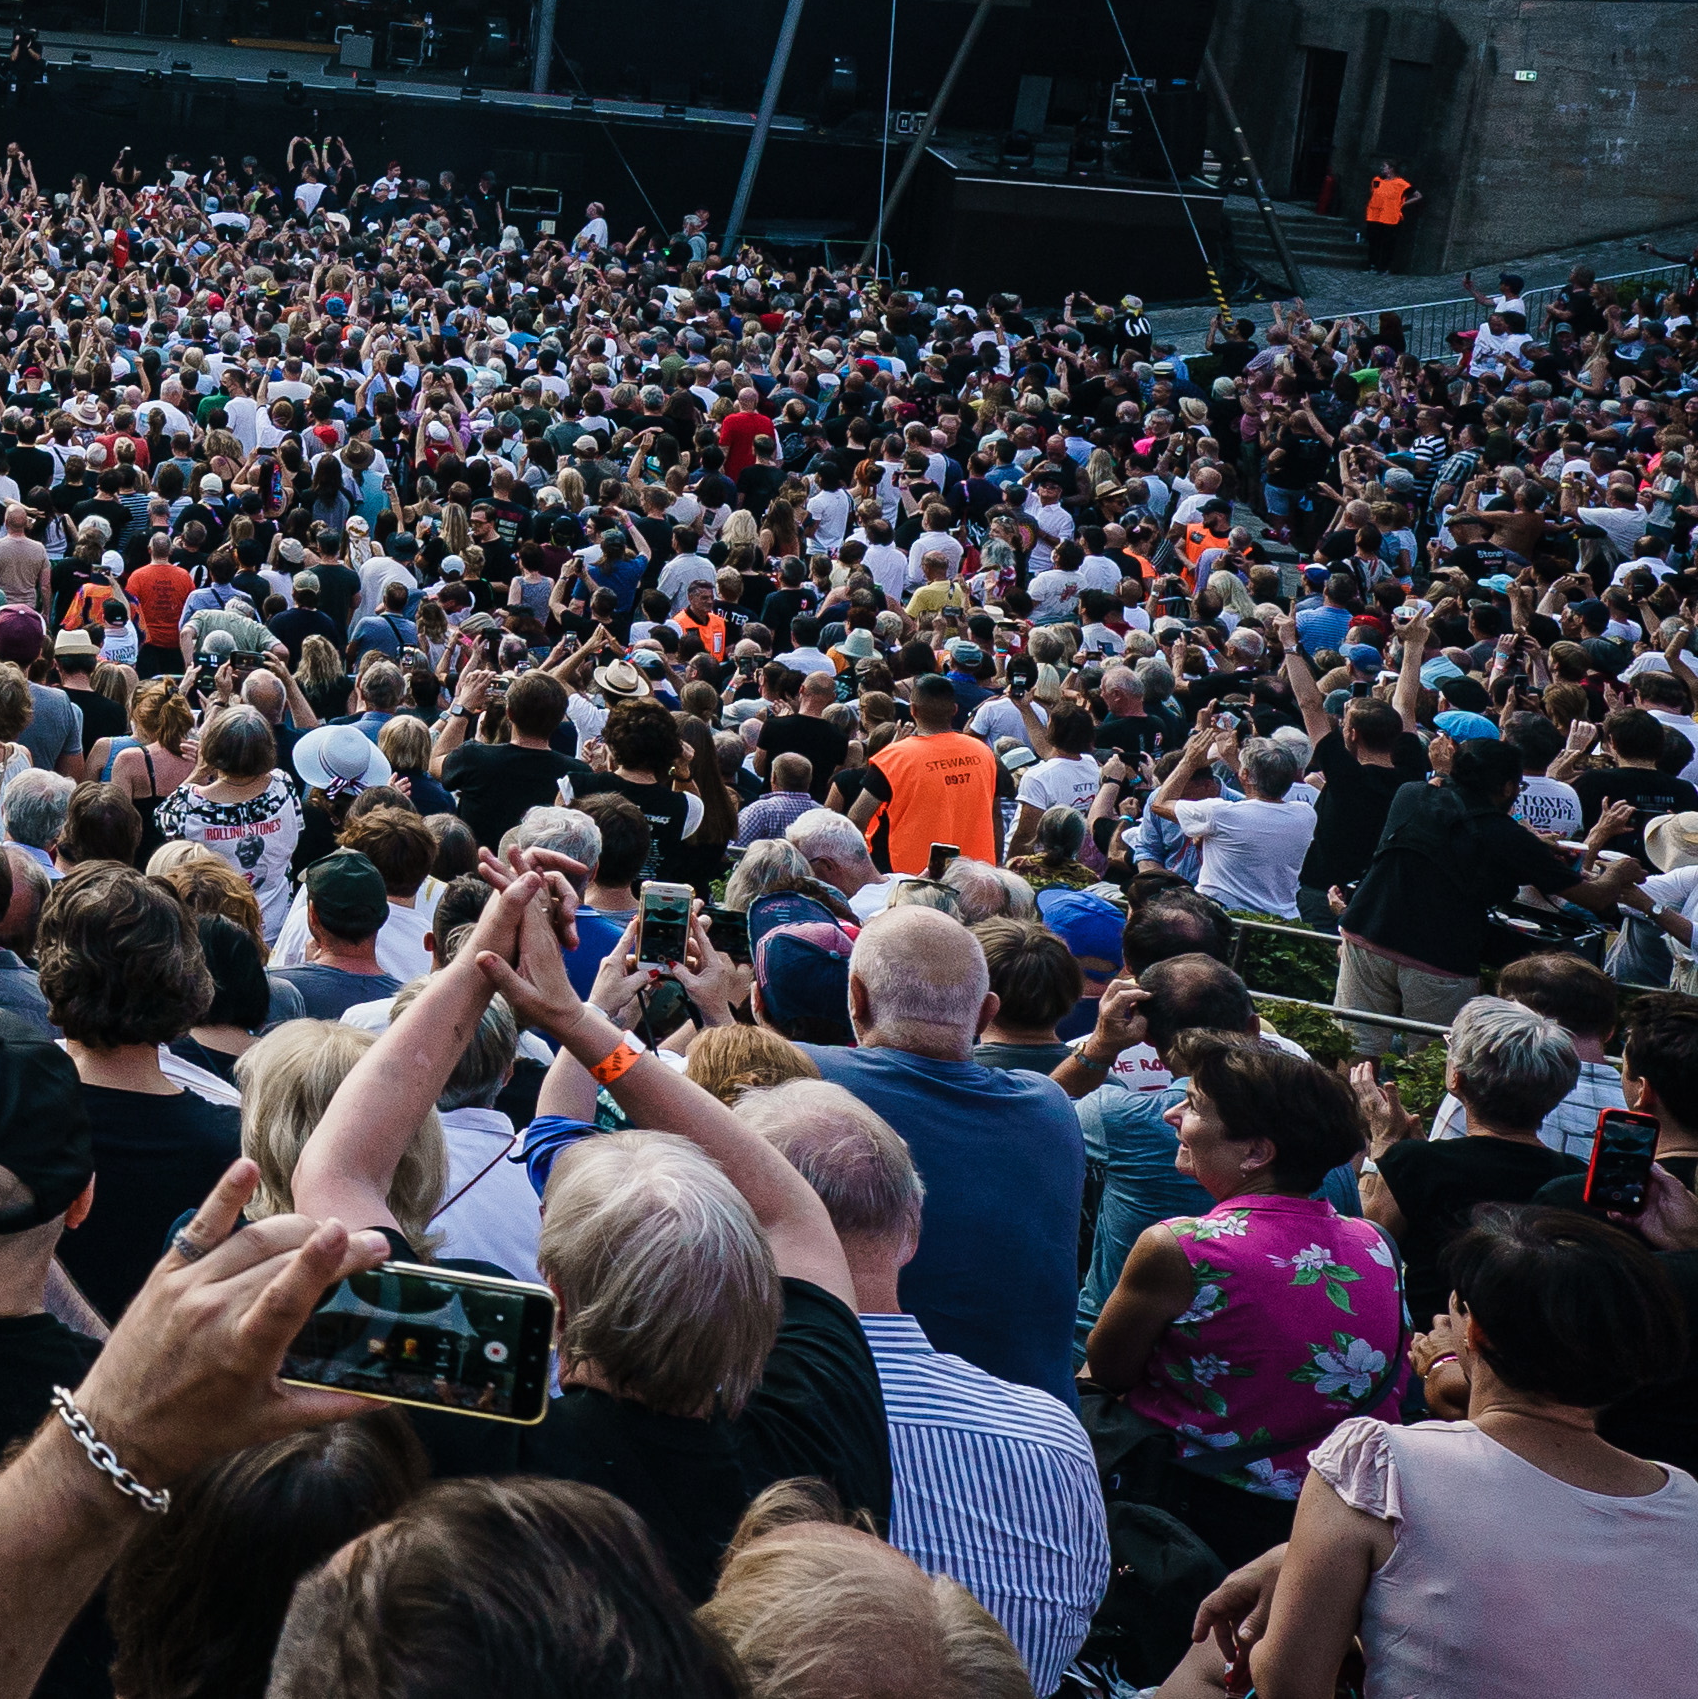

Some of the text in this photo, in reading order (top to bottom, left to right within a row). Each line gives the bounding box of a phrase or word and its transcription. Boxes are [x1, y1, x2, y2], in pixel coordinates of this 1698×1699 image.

[1125, 317, 1151, 337] 60
[925, 755, 981, 772] STEWARD
[945, 773, 970, 786] 0937
[205, 818, 282, 841] ROLLING STONES
